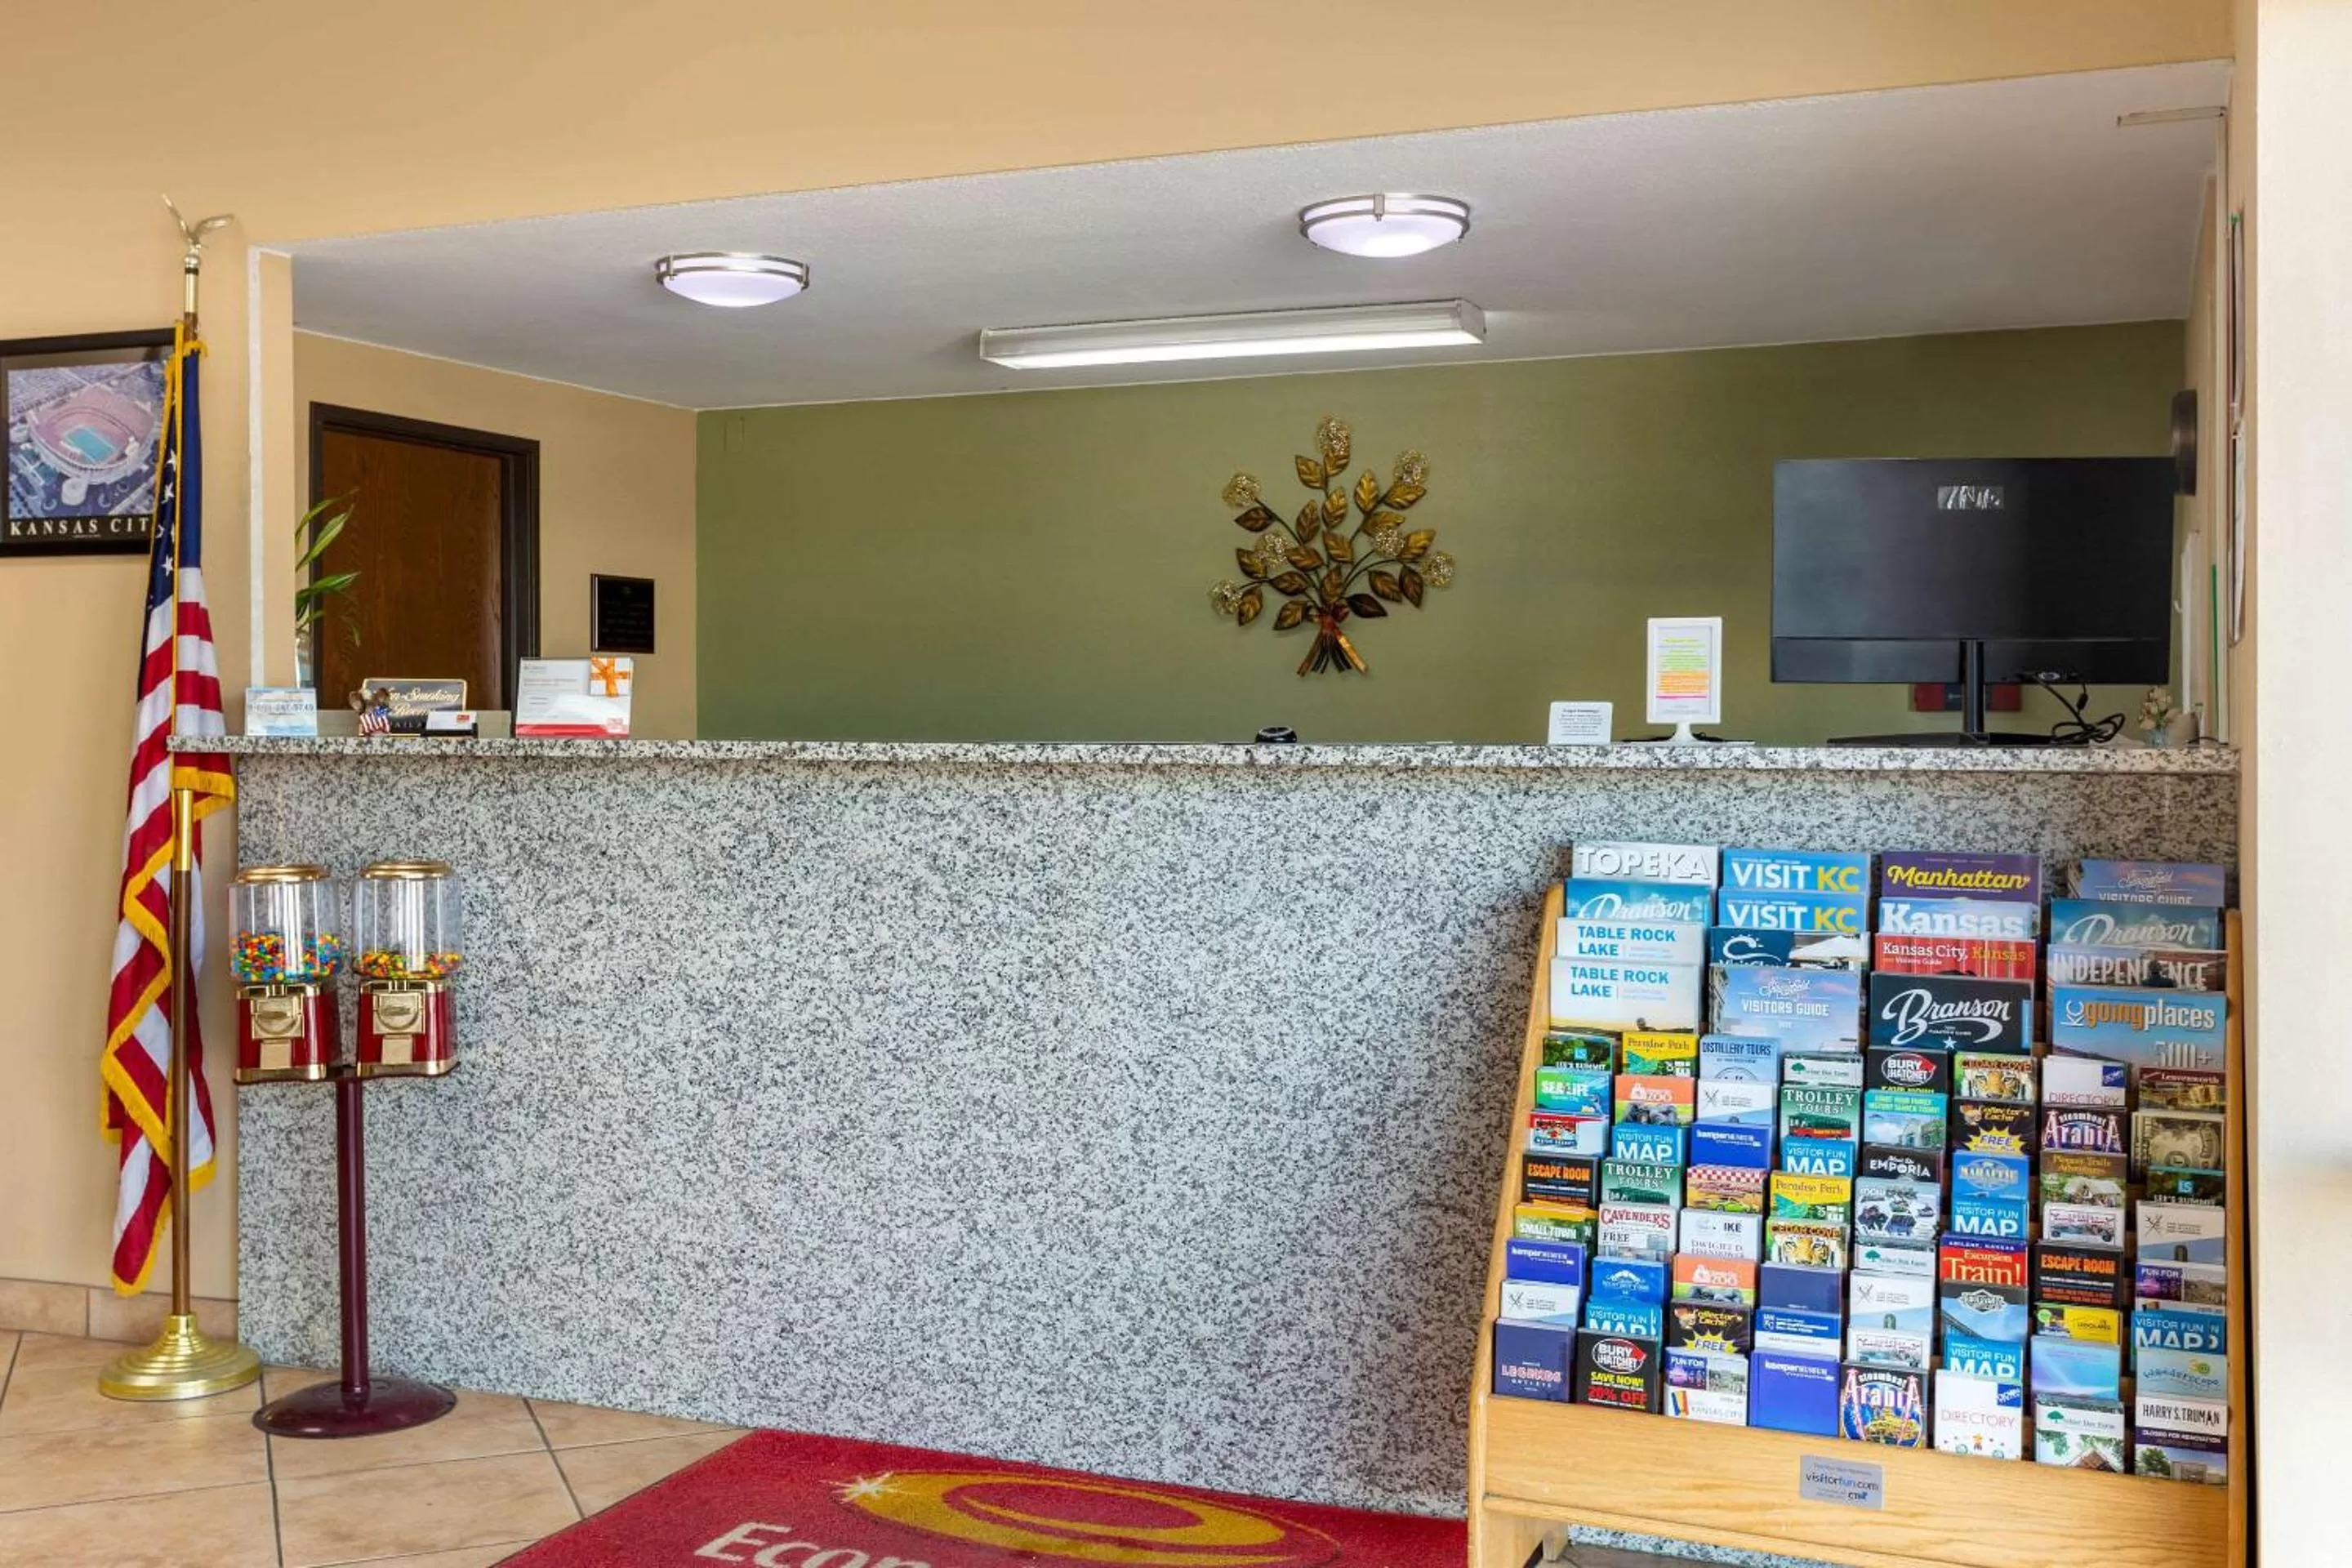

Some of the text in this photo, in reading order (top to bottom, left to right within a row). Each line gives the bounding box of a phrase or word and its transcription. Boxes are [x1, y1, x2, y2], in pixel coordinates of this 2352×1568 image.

[10, 516, 152, 537] KANSAS CIT
[1577, 846, 1710, 880] TOPEKA
[1731, 862, 1860, 893] VISIT KC
[1886, 865, 2032, 890] Manhattan
[1727, 902, 1858, 933] VISIT KC
[1881, 902, 2025, 938] Kansas
[1578, 926, 1677, 942] TABLE ROCK
[1578, 942, 1619, 956] LAKE
[1882, 942, 2026, 962] Kansas City, Kansas
[1570, 966, 1669, 984] TABLE ROCK
[1570, 983, 1612, 998] LAKE
[1741, 999, 1830, 1017] VISITORS GUIDE
[1881, 988, 2012, 1046] Branson
[1702, 1042, 1771, 1056] DISTILLERY TOURS
[1887, 1059, 1922, 1070] BURY
[1784, 1089, 1855, 1106] TROLLEY
[1617, 1132, 1673, 1143] VISITOR FUN
[1617, 1142, 1673, 1162] MAP
[1787, 1147, 1846, 1159] VISITOR FUN
[1527, 1164, 1591, 1181] ESCAPE ROOM
[1604, 1162, 1674, 1180] TROLLEY
[1786, 1156, 1846, 1176] MAP
[1869, 1160, 1931, 1178] EMPORIA
[1600, 1208, 1671, 1230] CAVENDER'S
[1956, 1206, 2019, 1219] VISITOR FUN
[1723, 1222, 1742, 1232] IKE
[1955, 1215, 2019, 1236] MAP
[1602, 1232, 1630, 1243] FREE
[1943, 1256, 2021, 1287] Train!
[2041, 1254, 2116, 1274] ESCAPE ROOM
[1589, 1310, 1647, 1325] VISITOR FUN
[2136, 1316, 2204, 1333] VISITOR FUN
[1589, 1319, 1647, 1335] MAP
[2136, 1327, 2203, 1350] MAP
[1598, 1343, 1633, 1356] BURY
[1951, 1348, 2016, 1363] VISITOR FUN
[1950, 1356, 2016, 1379] MAP
[1591, 1372, 1615, 1383] SAVE
[1588, 1385, 1647, 1405] 20% OFF
[1941, 1408, 2016, 1428] DIRECTORY
[2143, 1404, 2172, 1421] HARRY
[2182, 1409, 2221, 1427] TRUMAN
